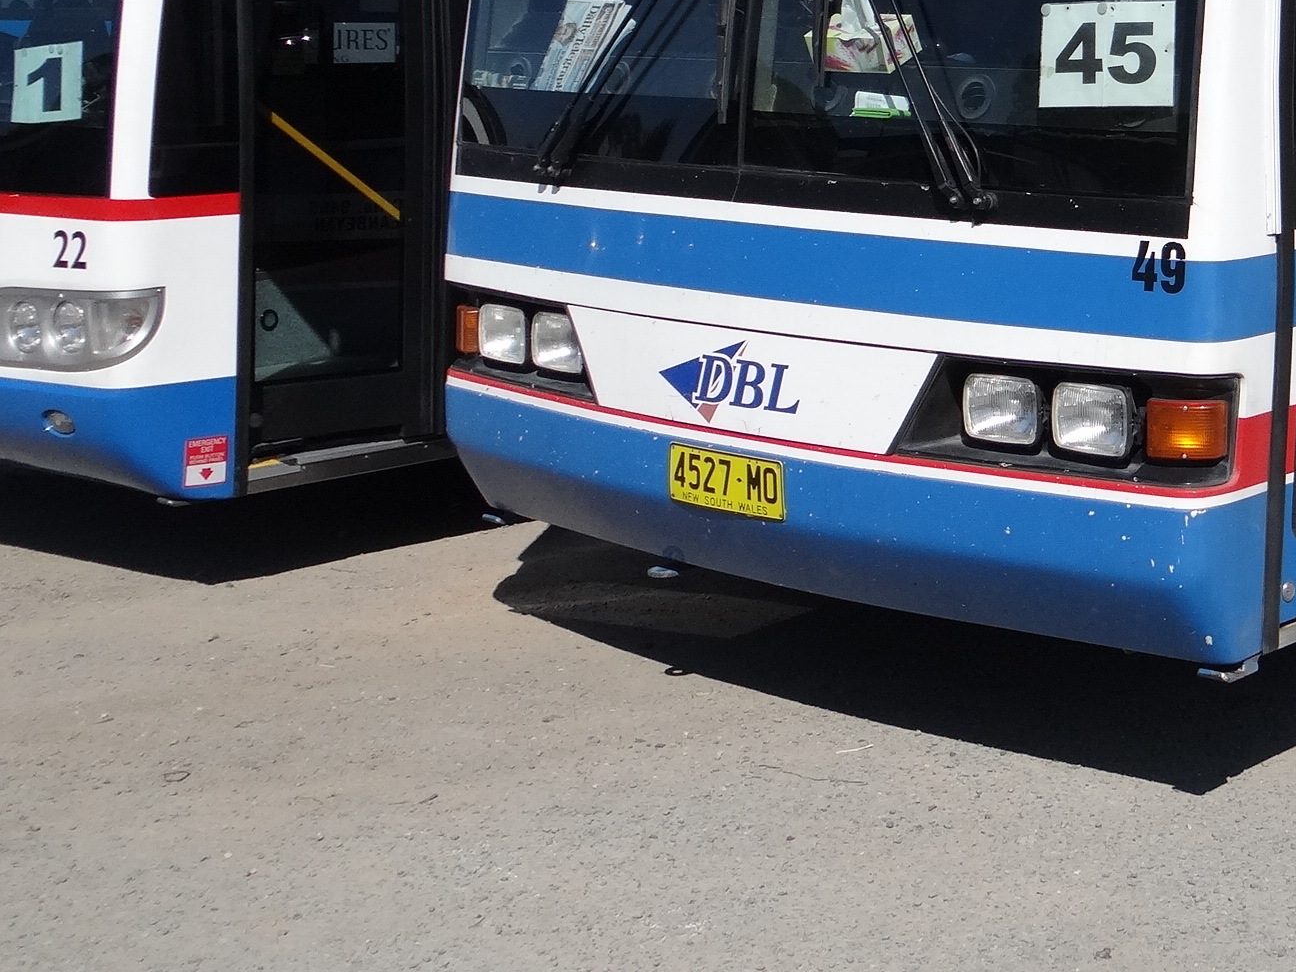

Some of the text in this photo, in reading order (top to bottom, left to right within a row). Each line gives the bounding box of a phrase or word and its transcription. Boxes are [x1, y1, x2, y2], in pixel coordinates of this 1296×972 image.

[579, 4, 601, 35] Daily
[1055, 21, 1157, 85] 45
[27, 57, 62, 112] 1
[53, 229, 87, 269] 22
[1132, 240, 1186, 294] 49
[694, 354, 800, 414] DBL
[188, 436, 227, 448] EMERGENCY
[200, 445, 214, 454] EXIT
[682, 492, 768, 516] NEW SOUTH WALES
